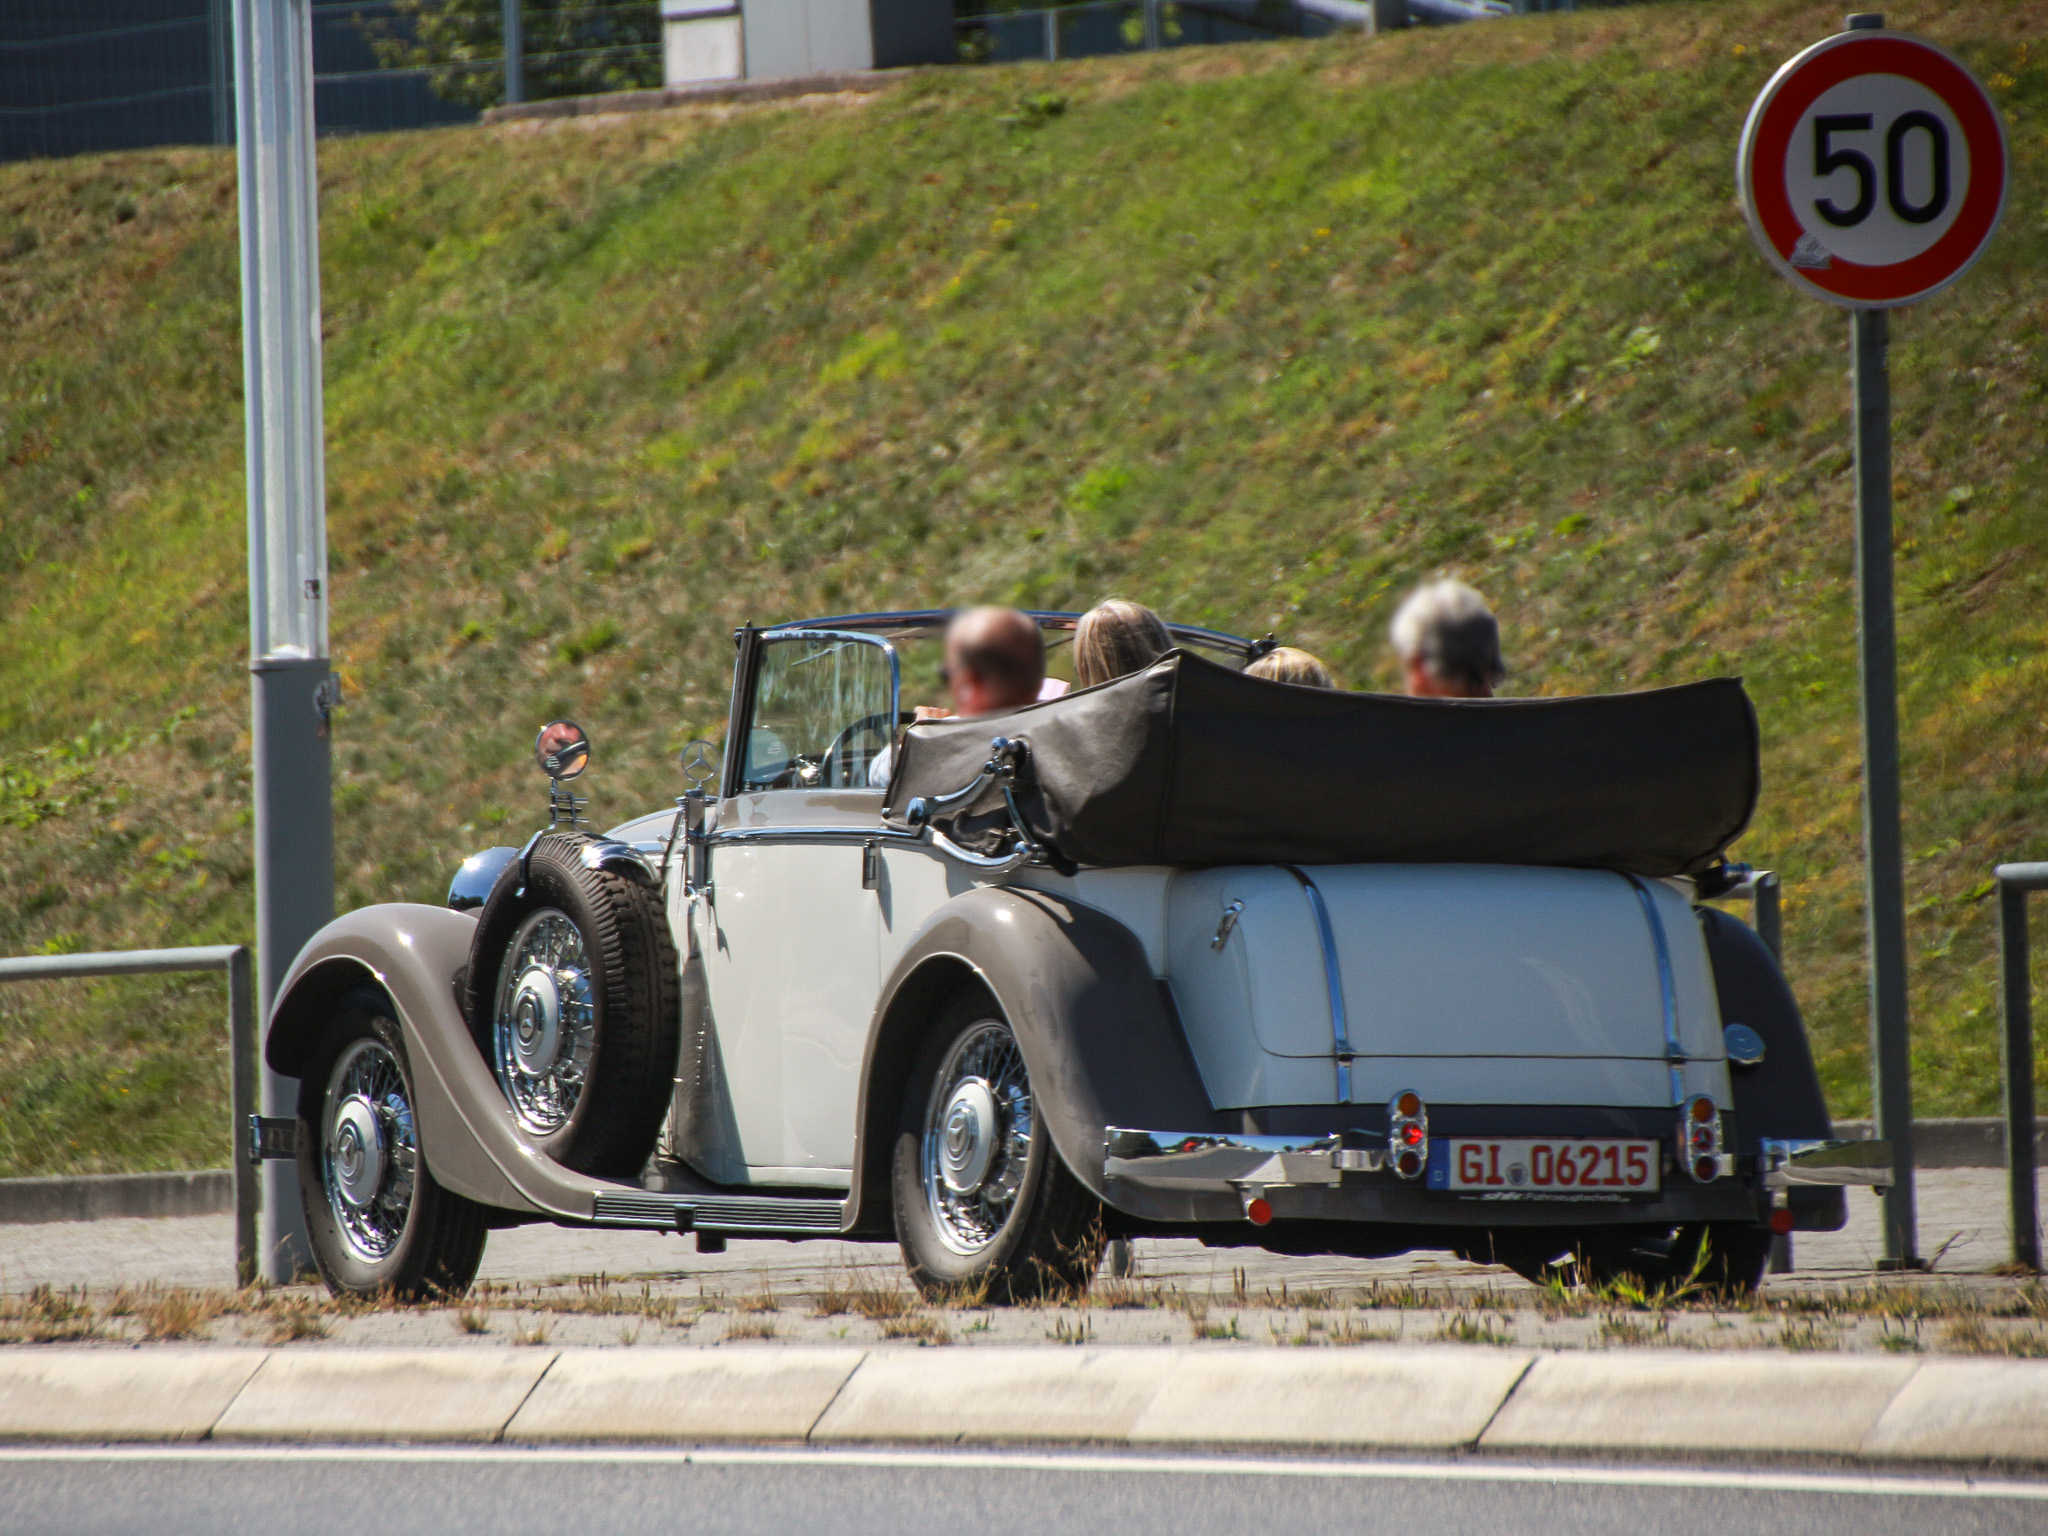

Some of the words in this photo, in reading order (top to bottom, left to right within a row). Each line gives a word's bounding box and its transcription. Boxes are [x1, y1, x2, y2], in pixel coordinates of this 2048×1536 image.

[1814, 110, 1950, 227] 50
[1434, 1170, 1443, 1181] D
[1459, 1144, 1504, 1185] GI
[1531, 1145, 1649, 1186] 06215
